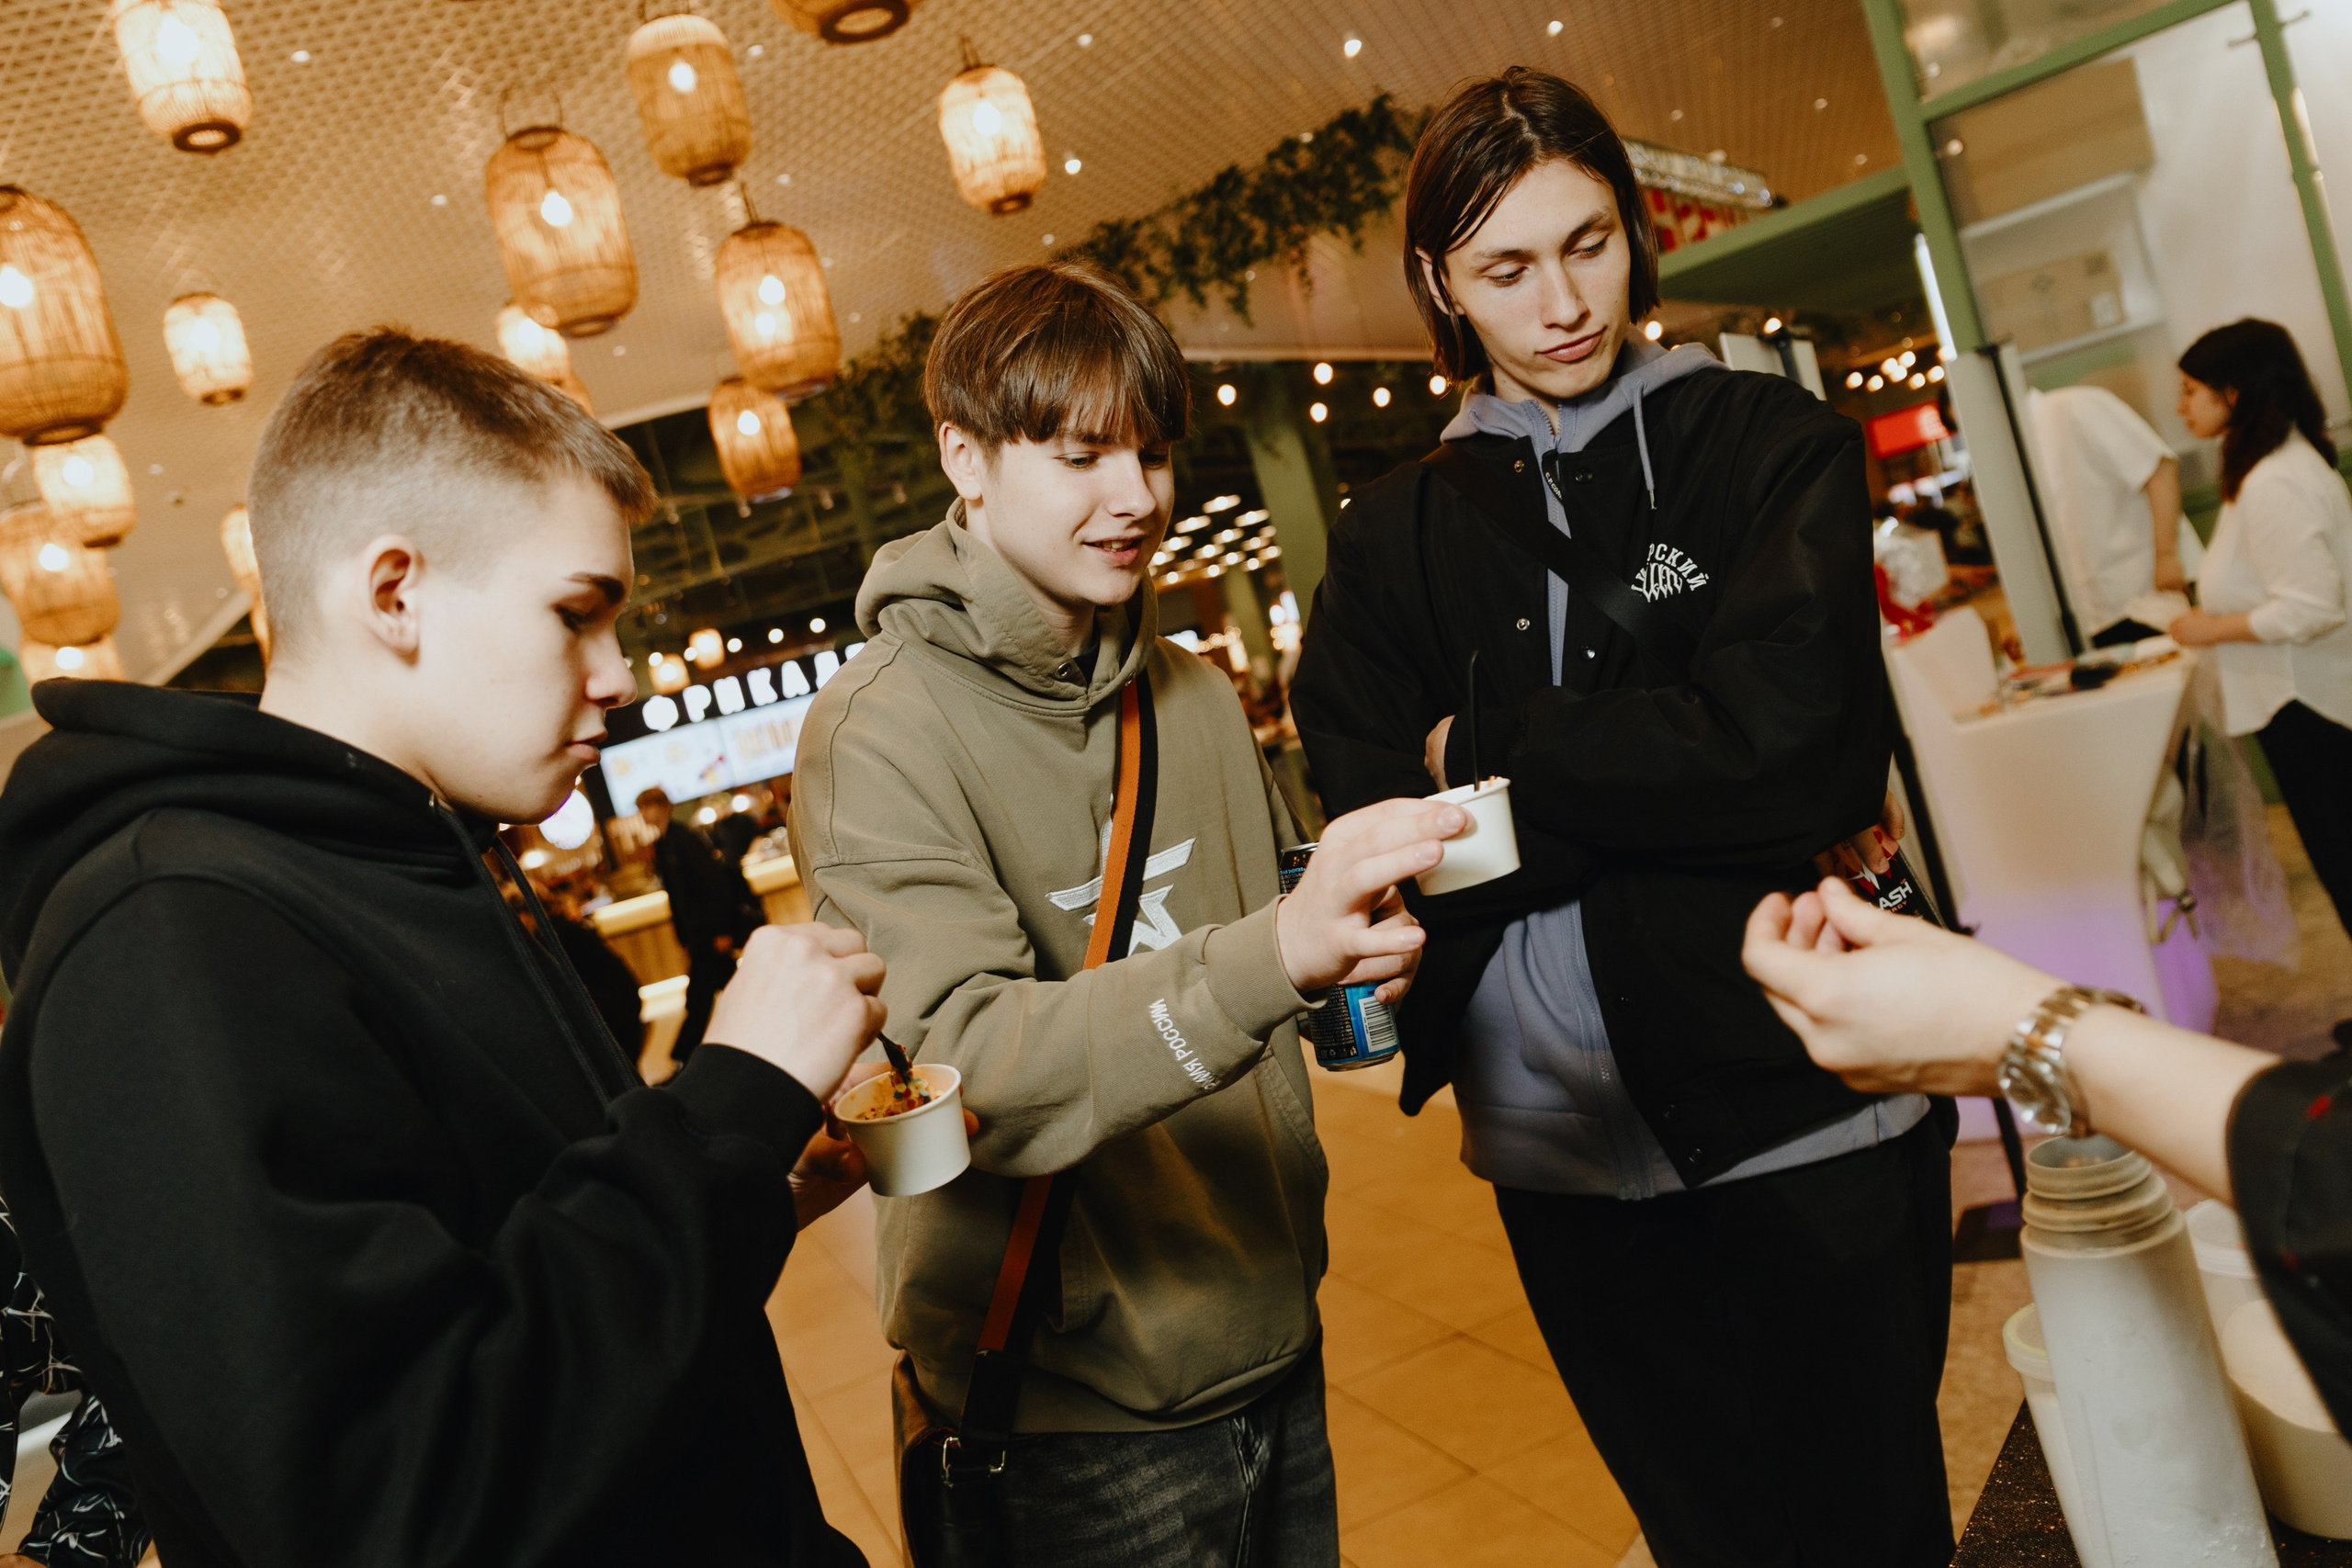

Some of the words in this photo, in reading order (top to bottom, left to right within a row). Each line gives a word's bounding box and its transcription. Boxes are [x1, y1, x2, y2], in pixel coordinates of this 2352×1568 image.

[1631, 543, 1710, 592] РСКИЙ
[1878, 881, 1913, 910] ASH
[1889, 900, 1907, 914] RGY
[1148, 998, 1194, 1061] РОССИИ
[1182, 1057, 1217, 1090] РМИЯ
